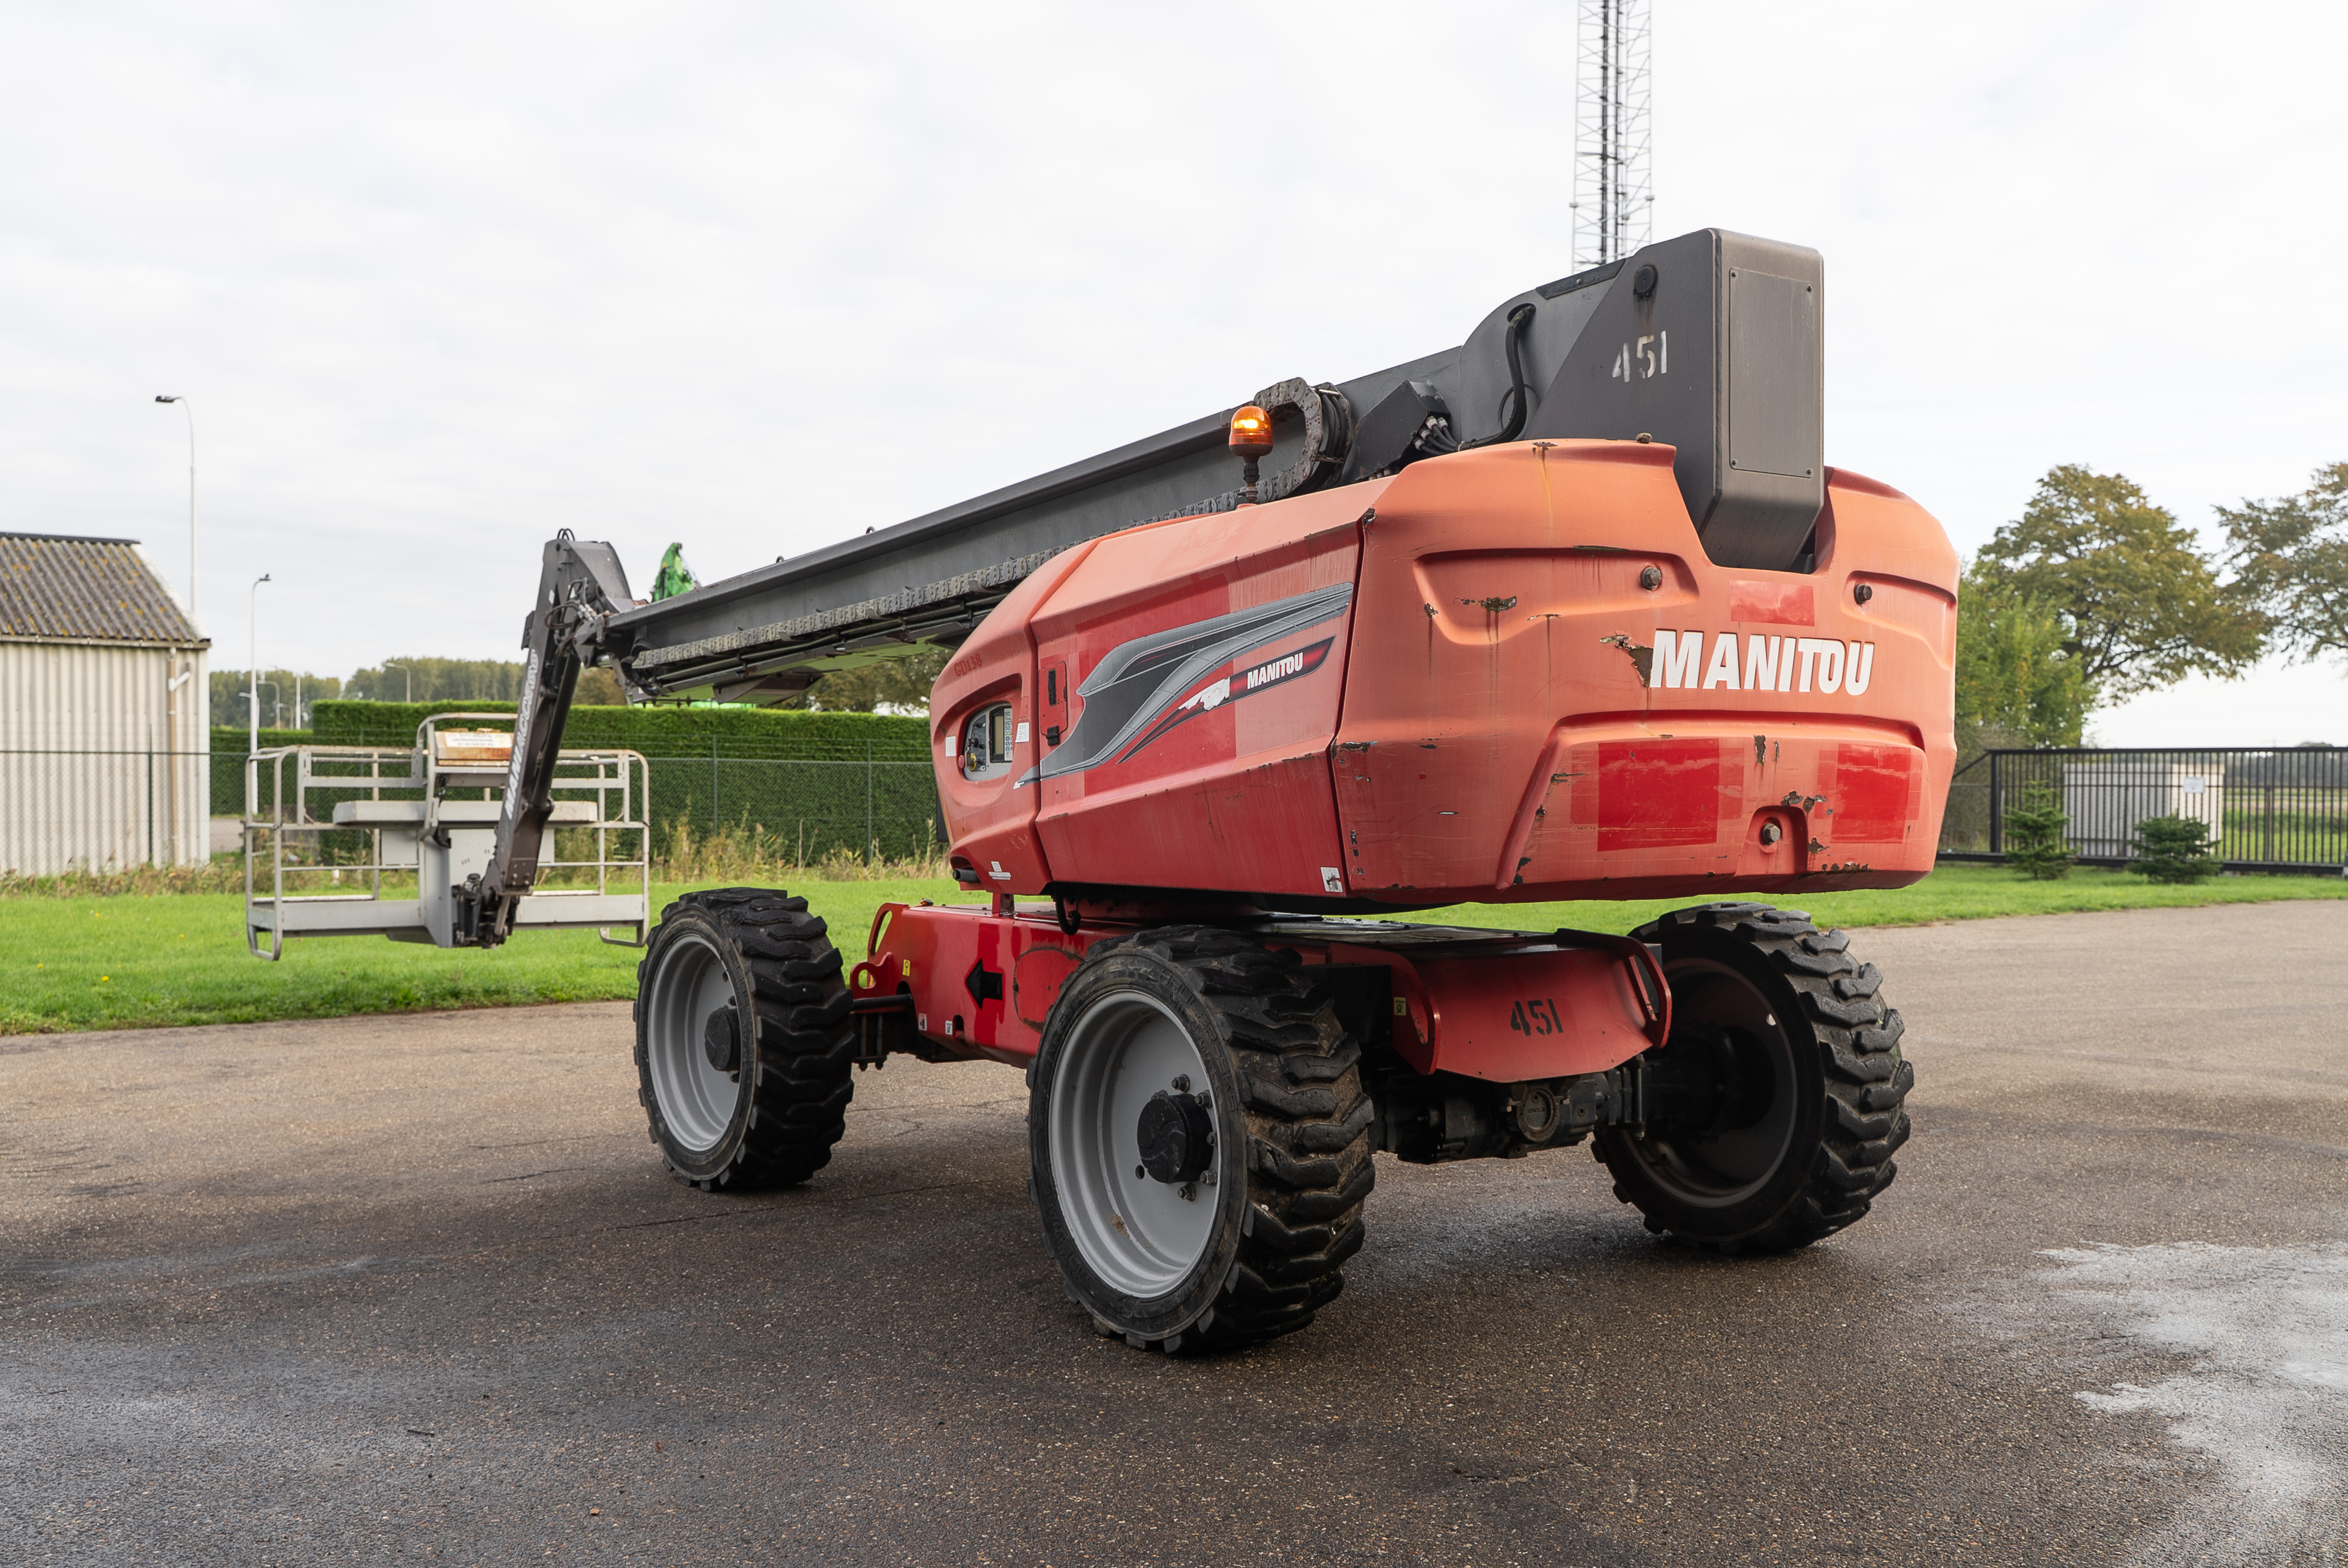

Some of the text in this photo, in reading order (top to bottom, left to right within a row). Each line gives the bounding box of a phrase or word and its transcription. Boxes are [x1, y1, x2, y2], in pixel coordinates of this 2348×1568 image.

[1611, 330, 1668, 383] 451
[954, 653, 983, 677] GD138
[1246, 652, 1304, 689] MANITOU
[1649, 629, 1874, 696] MANITOU
[1510, 998, 1564, 1036] 451
